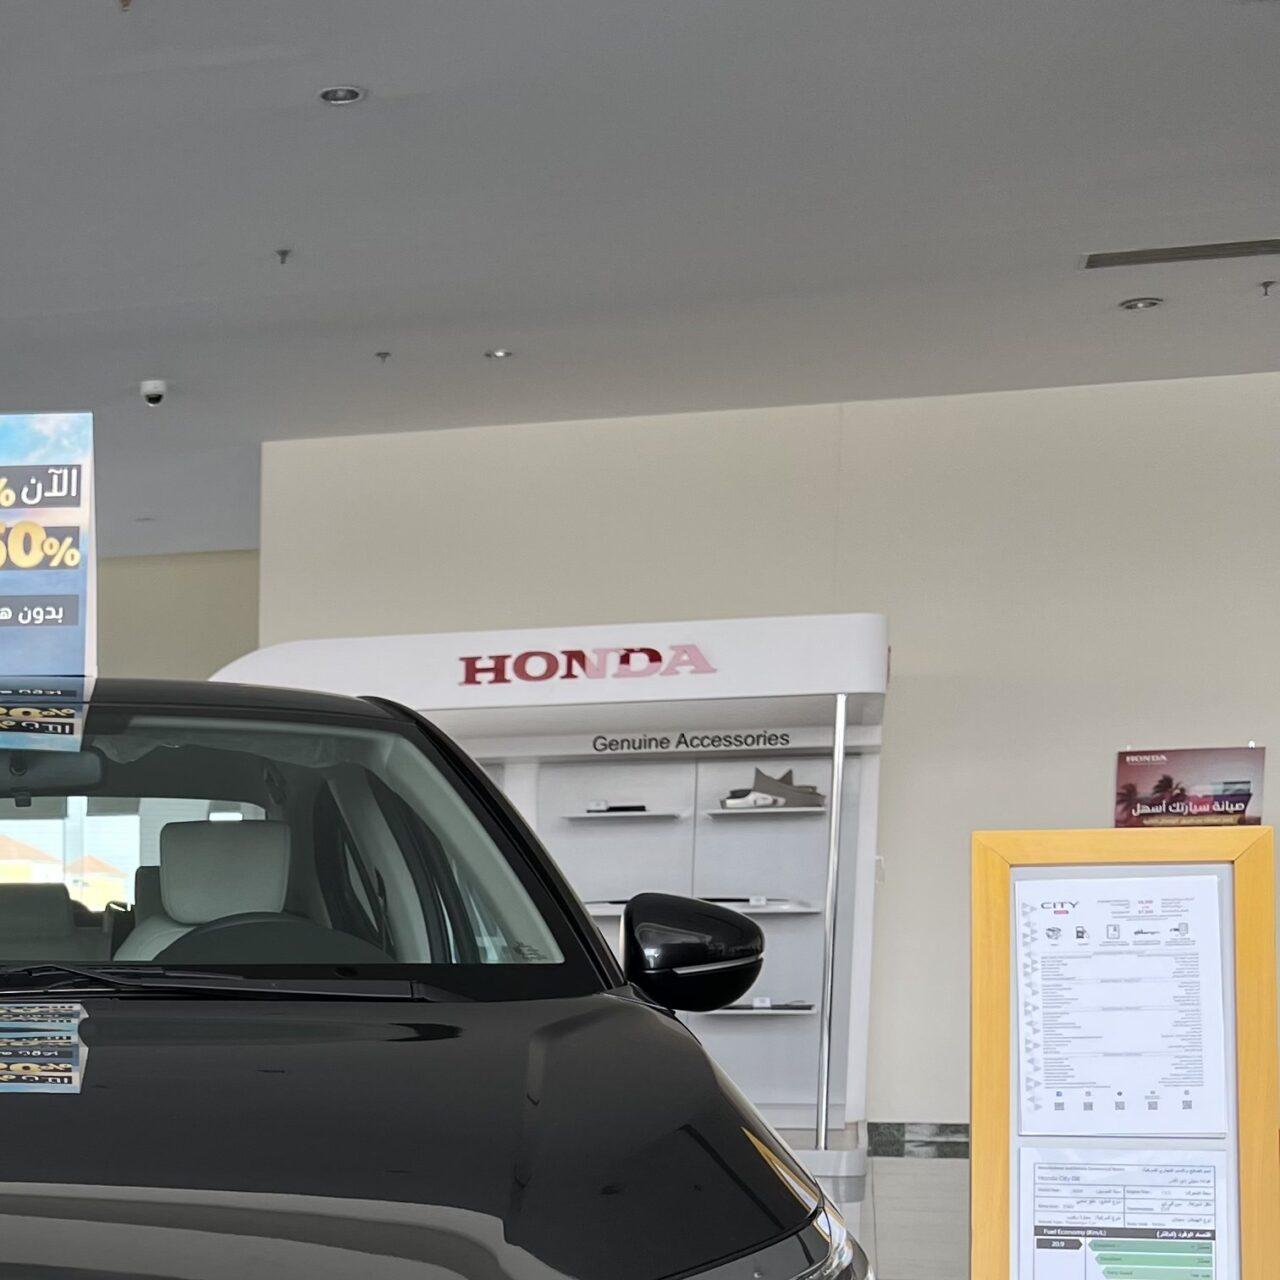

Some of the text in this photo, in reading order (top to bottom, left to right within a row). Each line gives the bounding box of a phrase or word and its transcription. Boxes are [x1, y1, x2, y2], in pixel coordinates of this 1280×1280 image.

[21, 467, 78, 505] الآن
[18, 605, 64, 624] بدون
[458, 644, 718, 686] HONDA
[592, 729, 790, 752] Genuine Accessories
[1131, 800, 1245, 816] صيانة سيارتك أسهل
[1041, 901, 1080, 909] CITY
